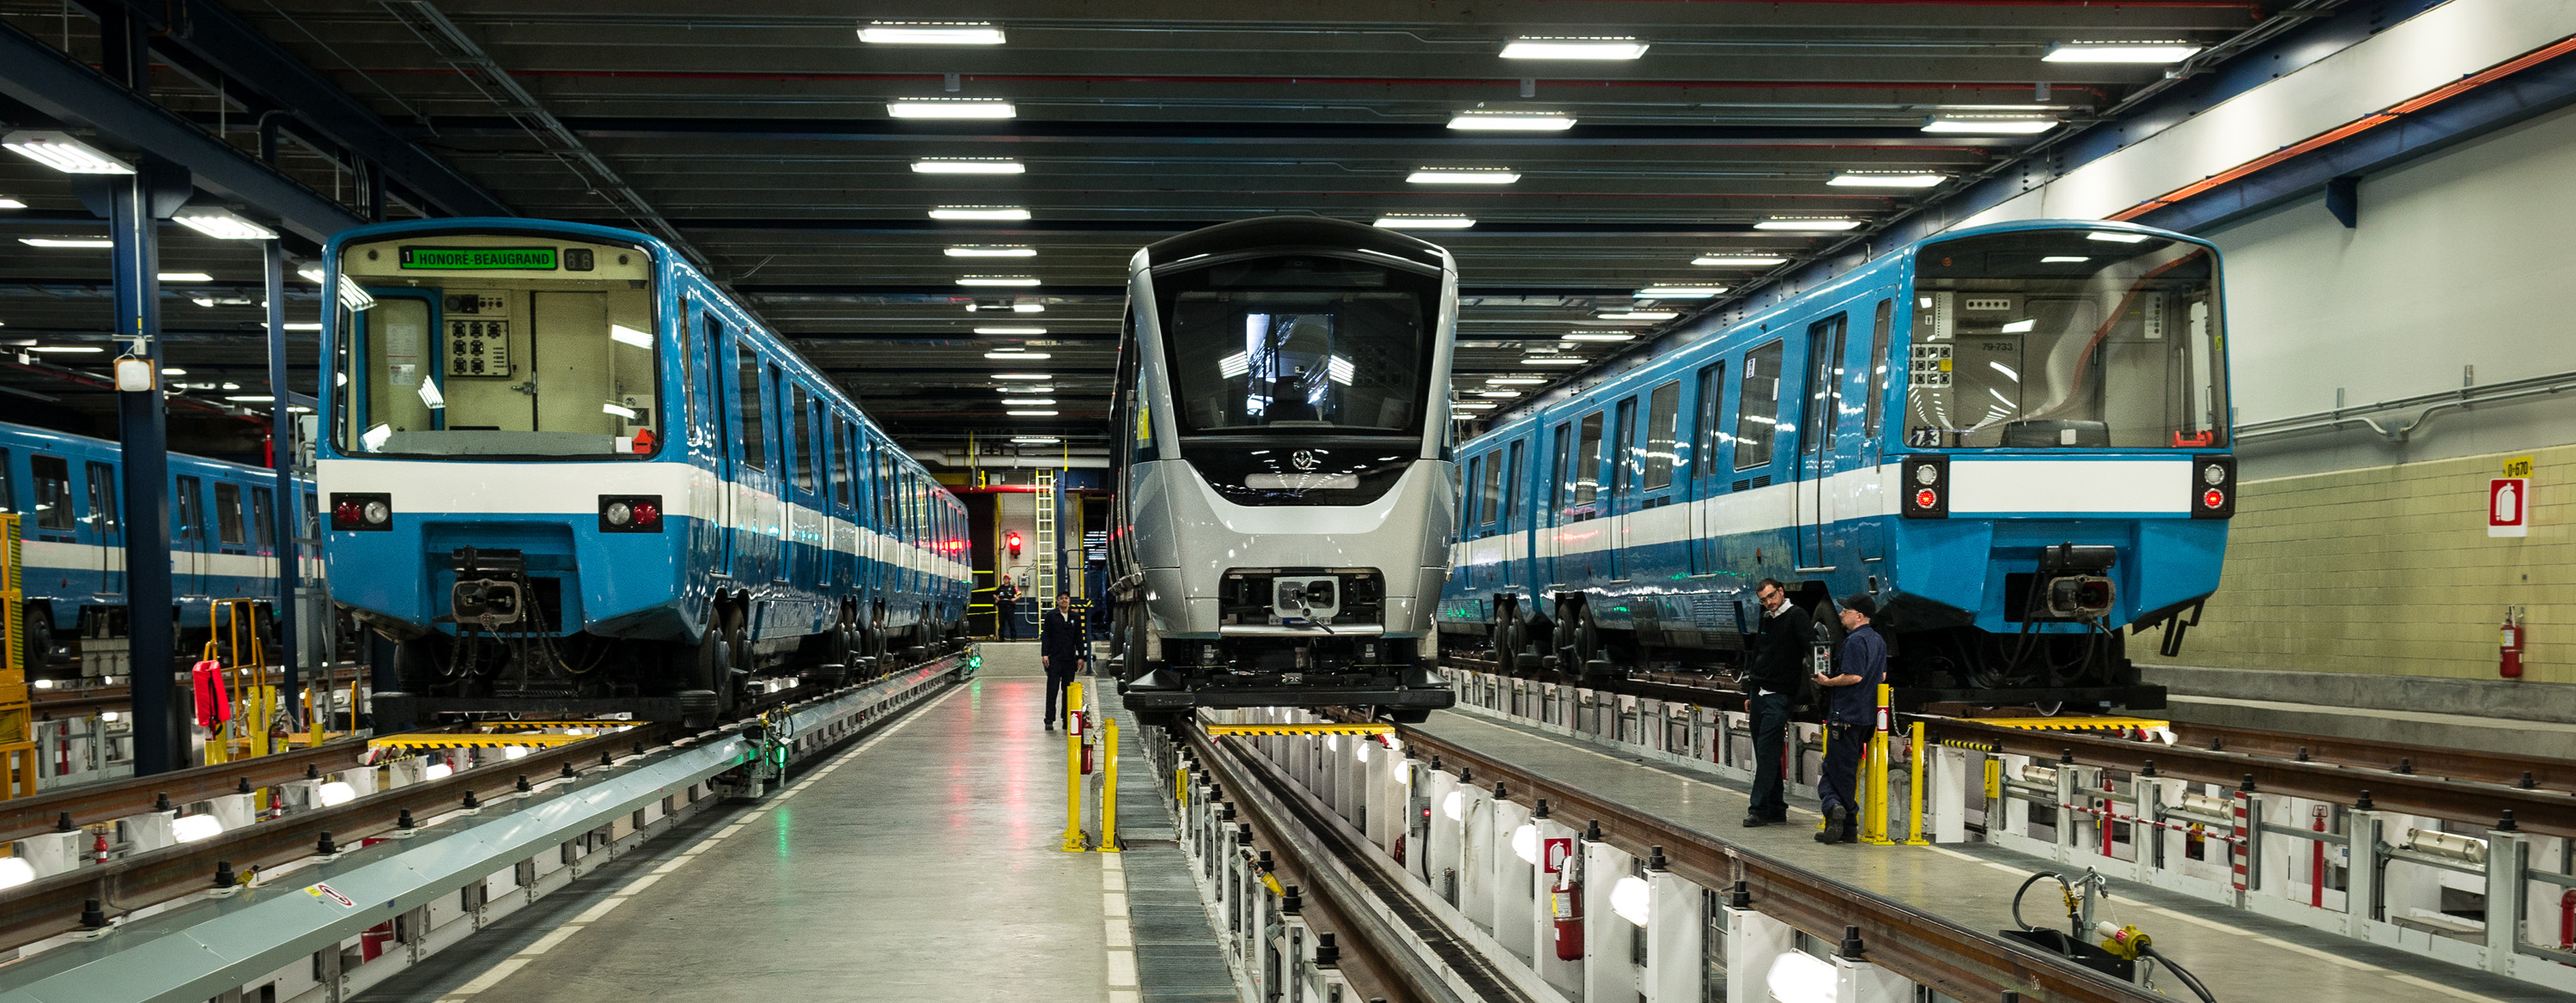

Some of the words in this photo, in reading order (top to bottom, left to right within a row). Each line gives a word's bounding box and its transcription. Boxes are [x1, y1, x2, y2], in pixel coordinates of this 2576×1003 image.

[405, 251, 410, 262] 1
[419, 251, 550, 265] HONORÉ-BEAUGRAND
[1982, 343, 2014, 351] 79-733
[1916, 430, 1941, 447] 73
